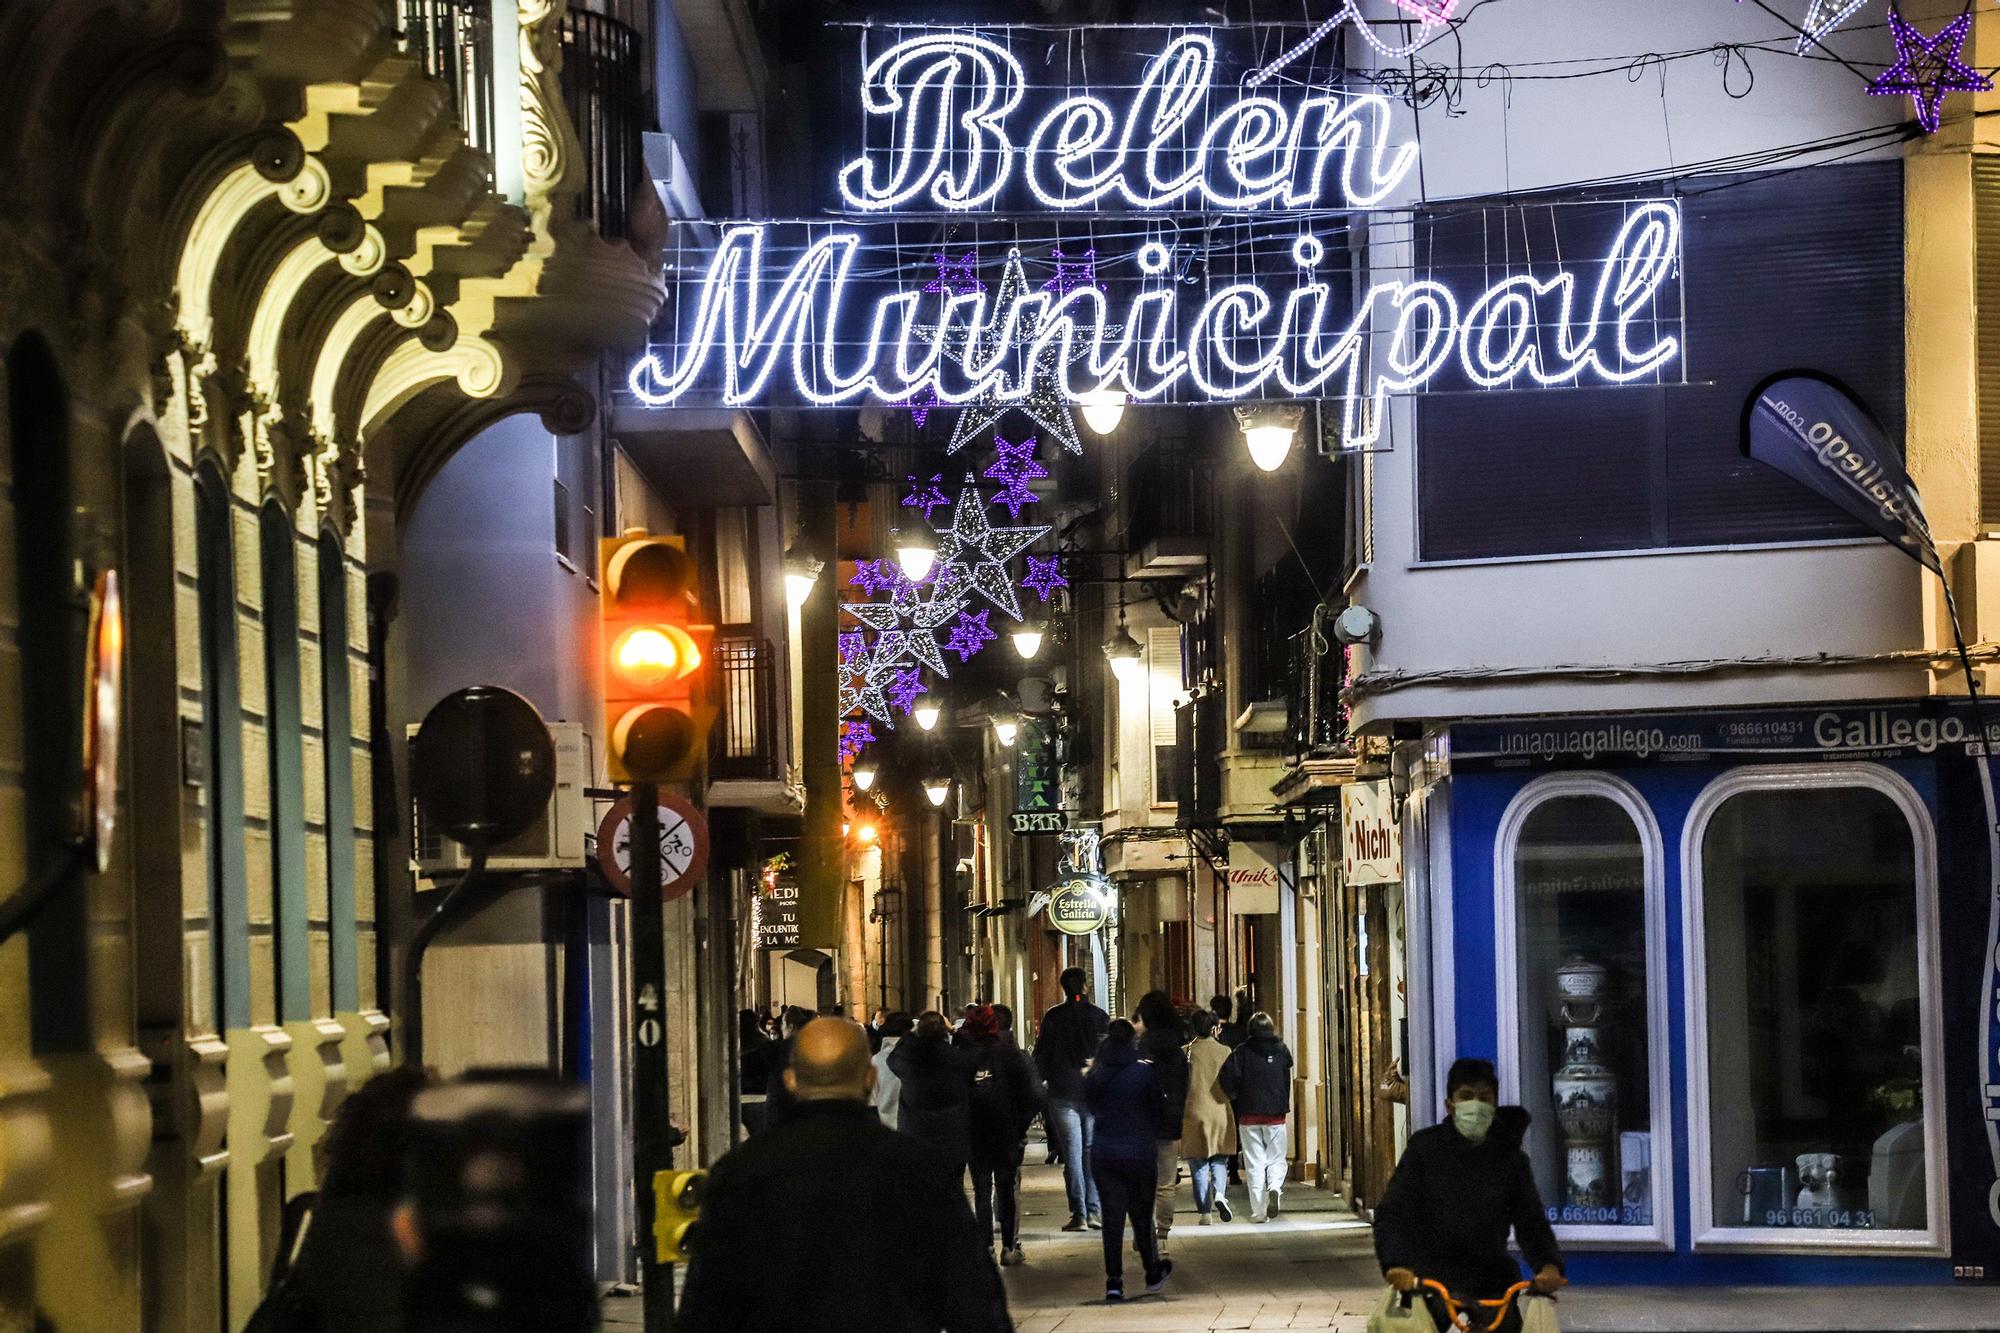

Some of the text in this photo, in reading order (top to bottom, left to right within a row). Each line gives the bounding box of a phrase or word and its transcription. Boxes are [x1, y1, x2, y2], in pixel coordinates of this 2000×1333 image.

[839, 34, 1418, 208] Belen
[628, 202, 1678, 447] Municipal
[1729, 721, 1804, 736] 966610431
[1500, 725, 1702, 761] uniaguagallego.com
[1011, 813, 1063, 832] BAR
[1355, 818, 1391, 860] Nichi
[1229, 866, 1278, 887] Unik's
[770, 887, 799, 899] EDI
[1058, 898, 1097, 909] Estrella
[782, 913, 796, 922] TU
[1060, 908, 1095, 919] Galicia
[766, 936, 778, 945] LA
[1545, 1206, 1641, 1222] 6 661 04 31
[1766, 1209, 1875, 1226] 96 661 04 31
